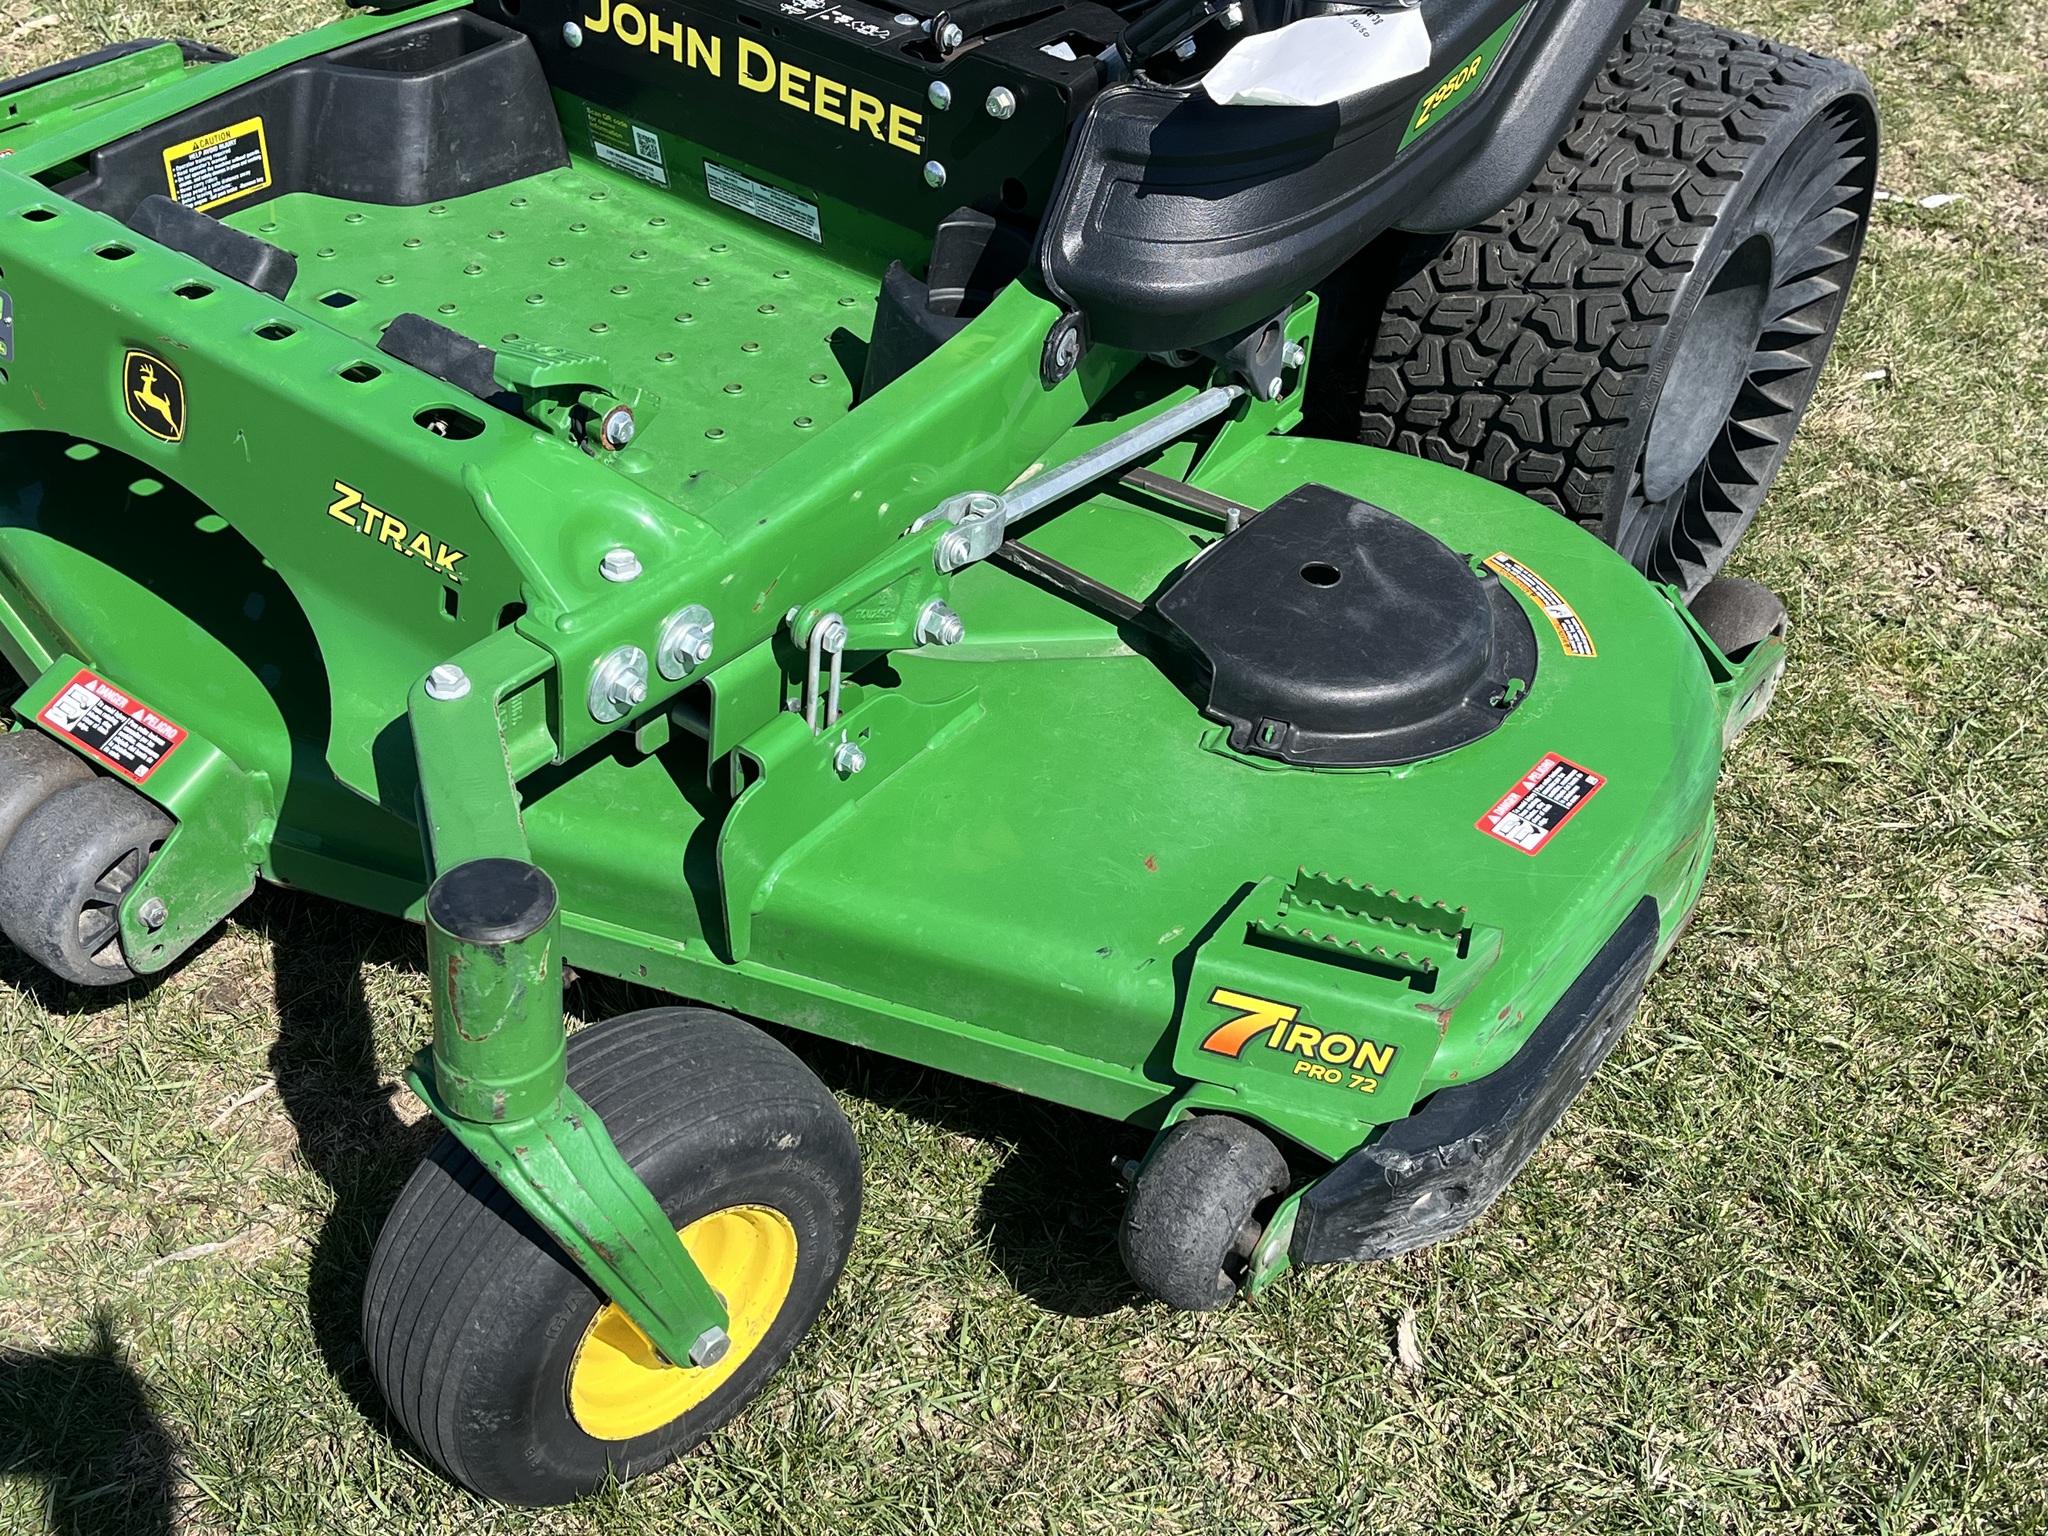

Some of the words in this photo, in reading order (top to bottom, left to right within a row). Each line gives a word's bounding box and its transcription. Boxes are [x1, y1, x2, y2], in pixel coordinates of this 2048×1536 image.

[585, 0, 722, 77] JOHN
[738, 36, 924, 155] DEERE
[1413, 54, 1483, 132] Z950R
[200, 131, 231, 148] CAUTION
[189, 151, 202, 160] HELP
[96, 684, 128, 708] DANGER
[143, 714, 178, 738] PELIGRO
[1293, 1060, 1343, 1084] PRO
[1346, 1074, 1379, 1095] 72
